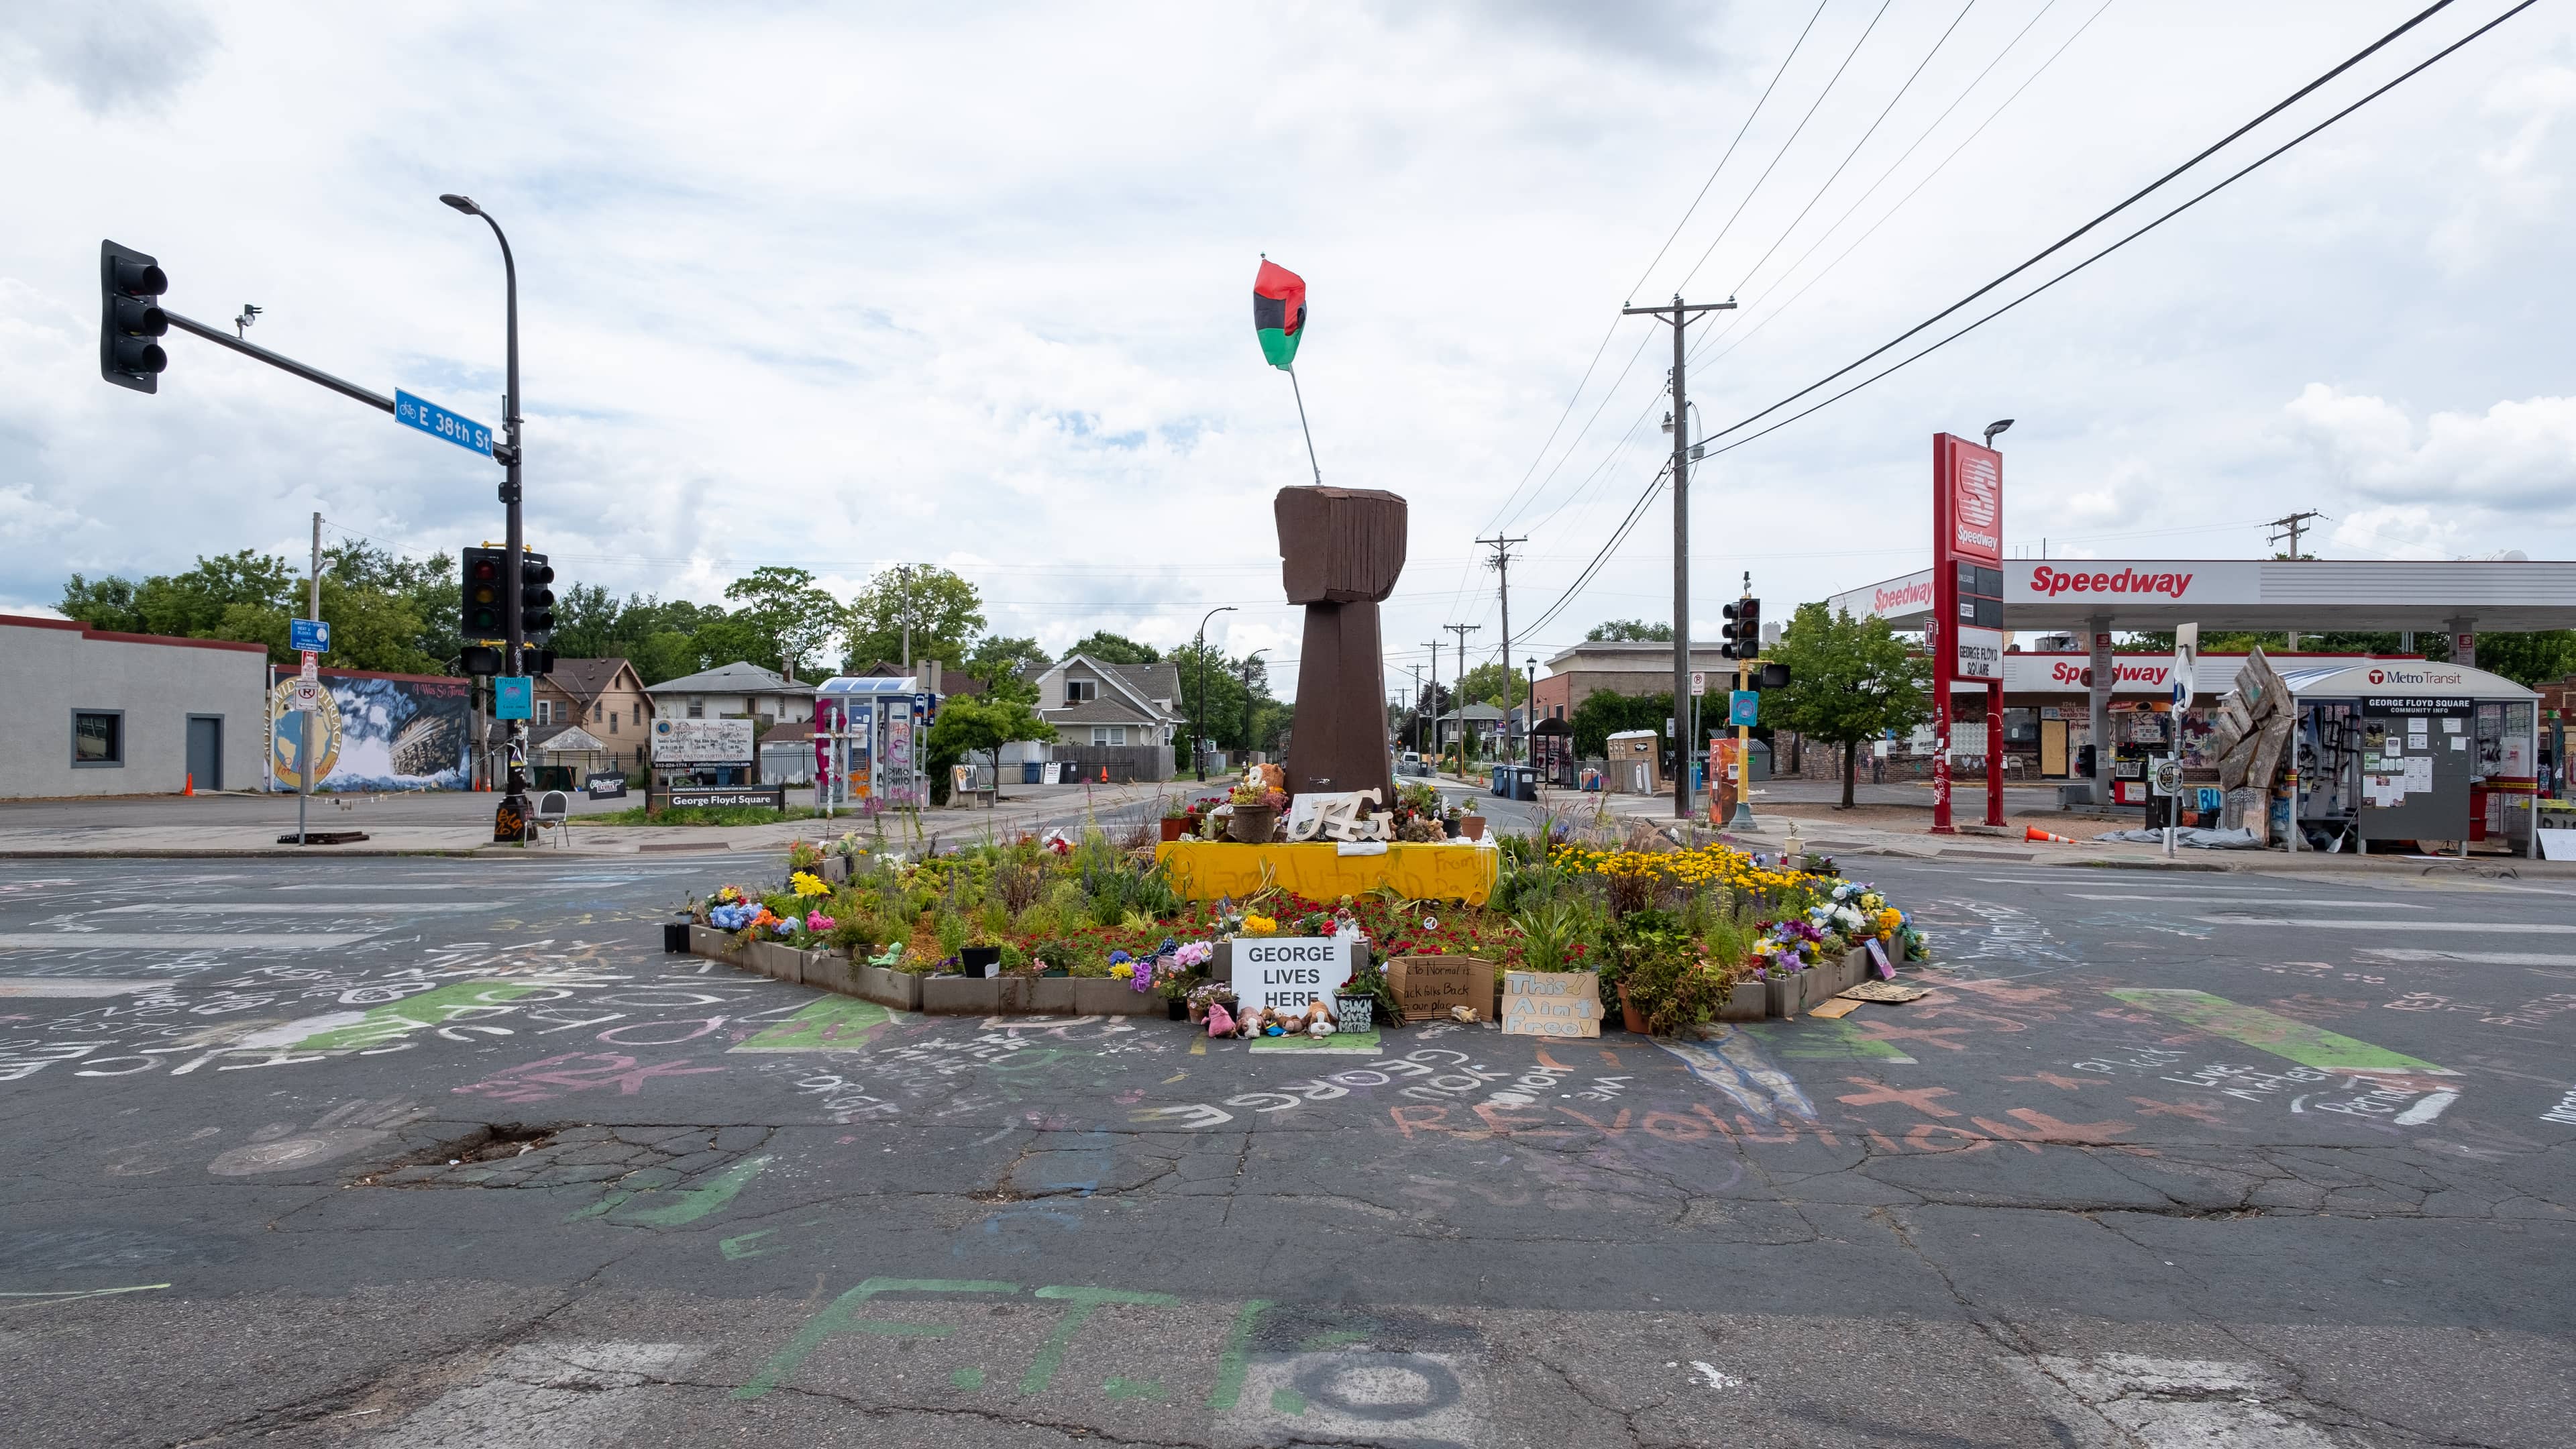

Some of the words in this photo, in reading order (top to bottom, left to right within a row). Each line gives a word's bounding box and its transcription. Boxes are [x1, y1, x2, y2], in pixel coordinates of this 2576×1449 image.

[420, 405, 429, 426] E
[435, 413, 470, 443] 38th
[475, 430, 490, 451] St
[1957, 525, 1998, 551] Speedway
[1958, 574, 1974, 584] UNLEADED
[2030, 566, 2193, 598] Speedway
[1874, 580, 1934, 614] Speedway
[1961, 605, 1973, 615] COFFEE
[1960, 645, 1980, 660] GEORGE
[1981, 647, 1998, 661] FLOYD
[1967, 662, 1990, 676] SQUARE
[2051, 661, 2169, 686] Spdway
[437, 685, 446, 698] So
[673, 796, 709, 806] George
[711, 796, 737, 806] Floyd
[739, 795, 771, 805] Square
[1248, 947, 1335, 963] GEORGE
[1415, 961, 1424, 975] to
[1427, 961, 1460, 976] Normal
[1264, 969, 1320, 984] LIVES
[1405, 984, 1421, 998] ack
[1424, 985, 1440, 997] folks
[1444, 982, 1469, 997] Back
[1265, 991, 1319, 1007] HERE
[1338, 1000, 1373, 1014] BLACK
[1338, 1012, 1371, 1022] LIVES
[1338, 1021, 1371, 1032] MATTER
